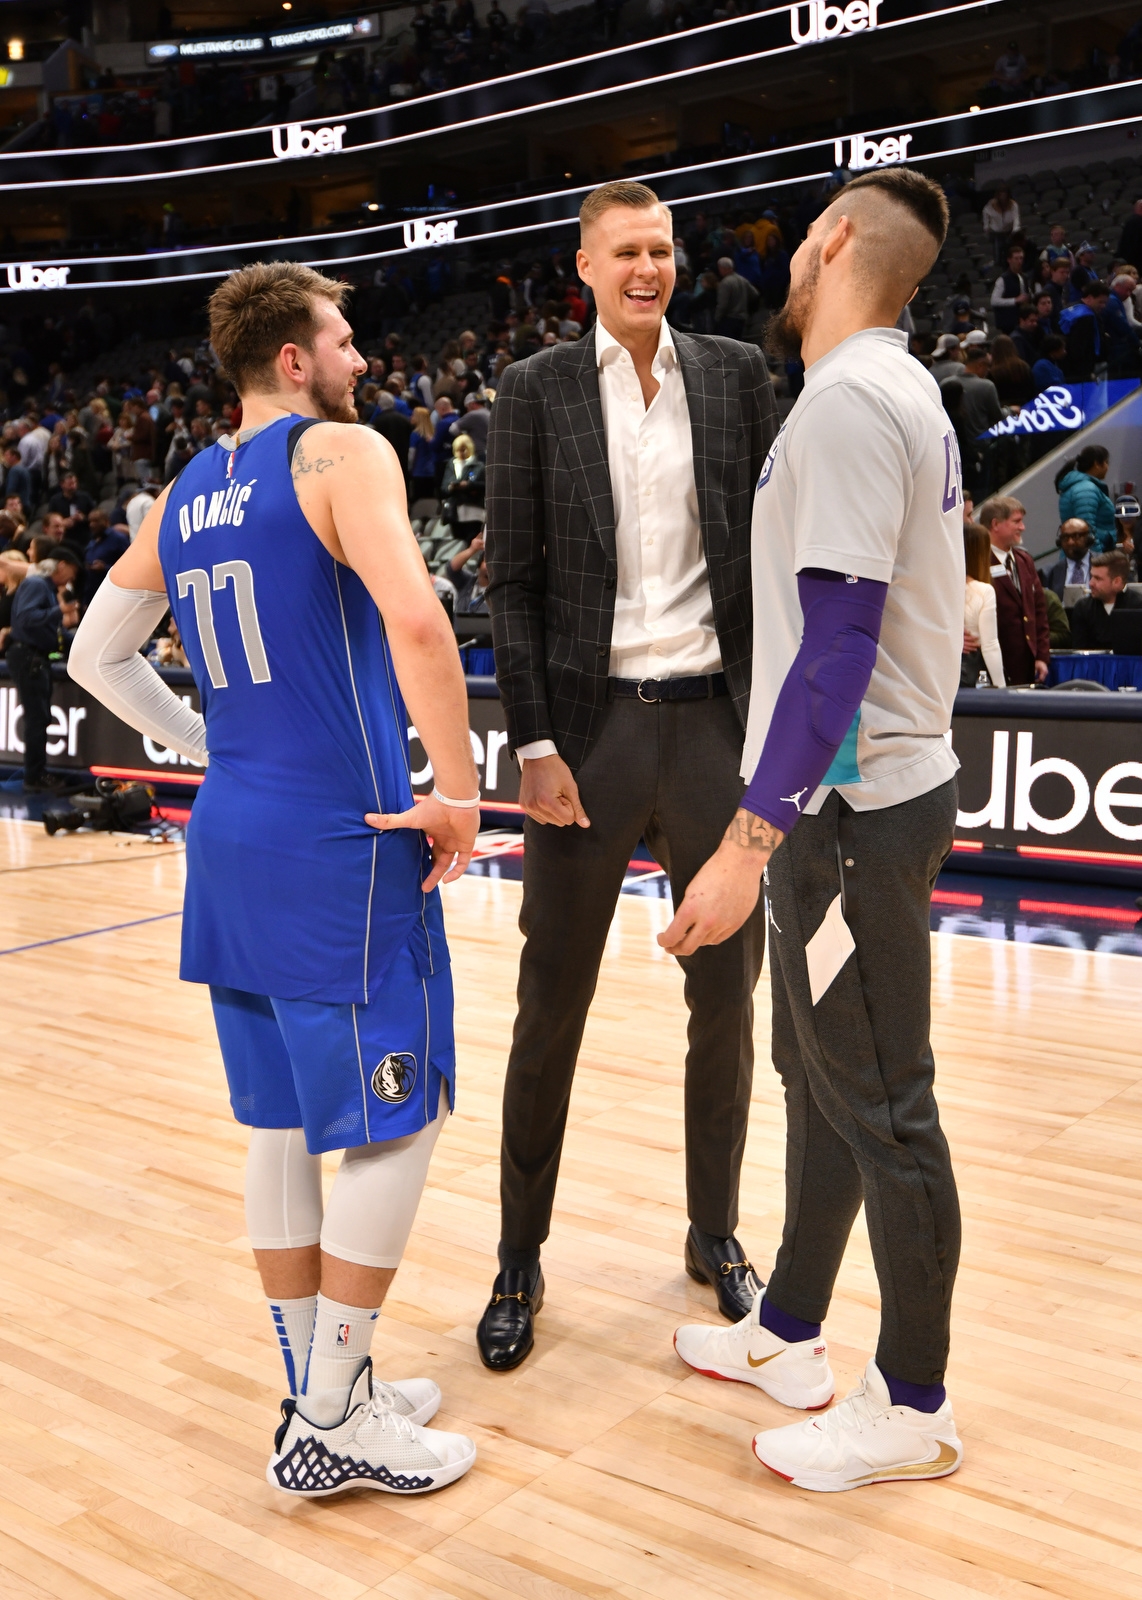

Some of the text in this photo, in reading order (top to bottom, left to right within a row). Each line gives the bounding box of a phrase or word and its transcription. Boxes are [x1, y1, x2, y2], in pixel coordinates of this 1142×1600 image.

[269, 23, 353, 47] TEXASFORD.COM
[790, 0, 883, 43] Uber
[179, 39, 232, 56] MUSTANG
[233, 37, 264, 51] CLUB
[272, 124, 347, 158] Uber
[834, 133, 912, 170] Uber
[403, 219, 458, 248] Uber
[7, 263, 70, 290] Uber
[179, 479, 257, 543] DONČIĆ
[176, 560, 272, 689] 77
